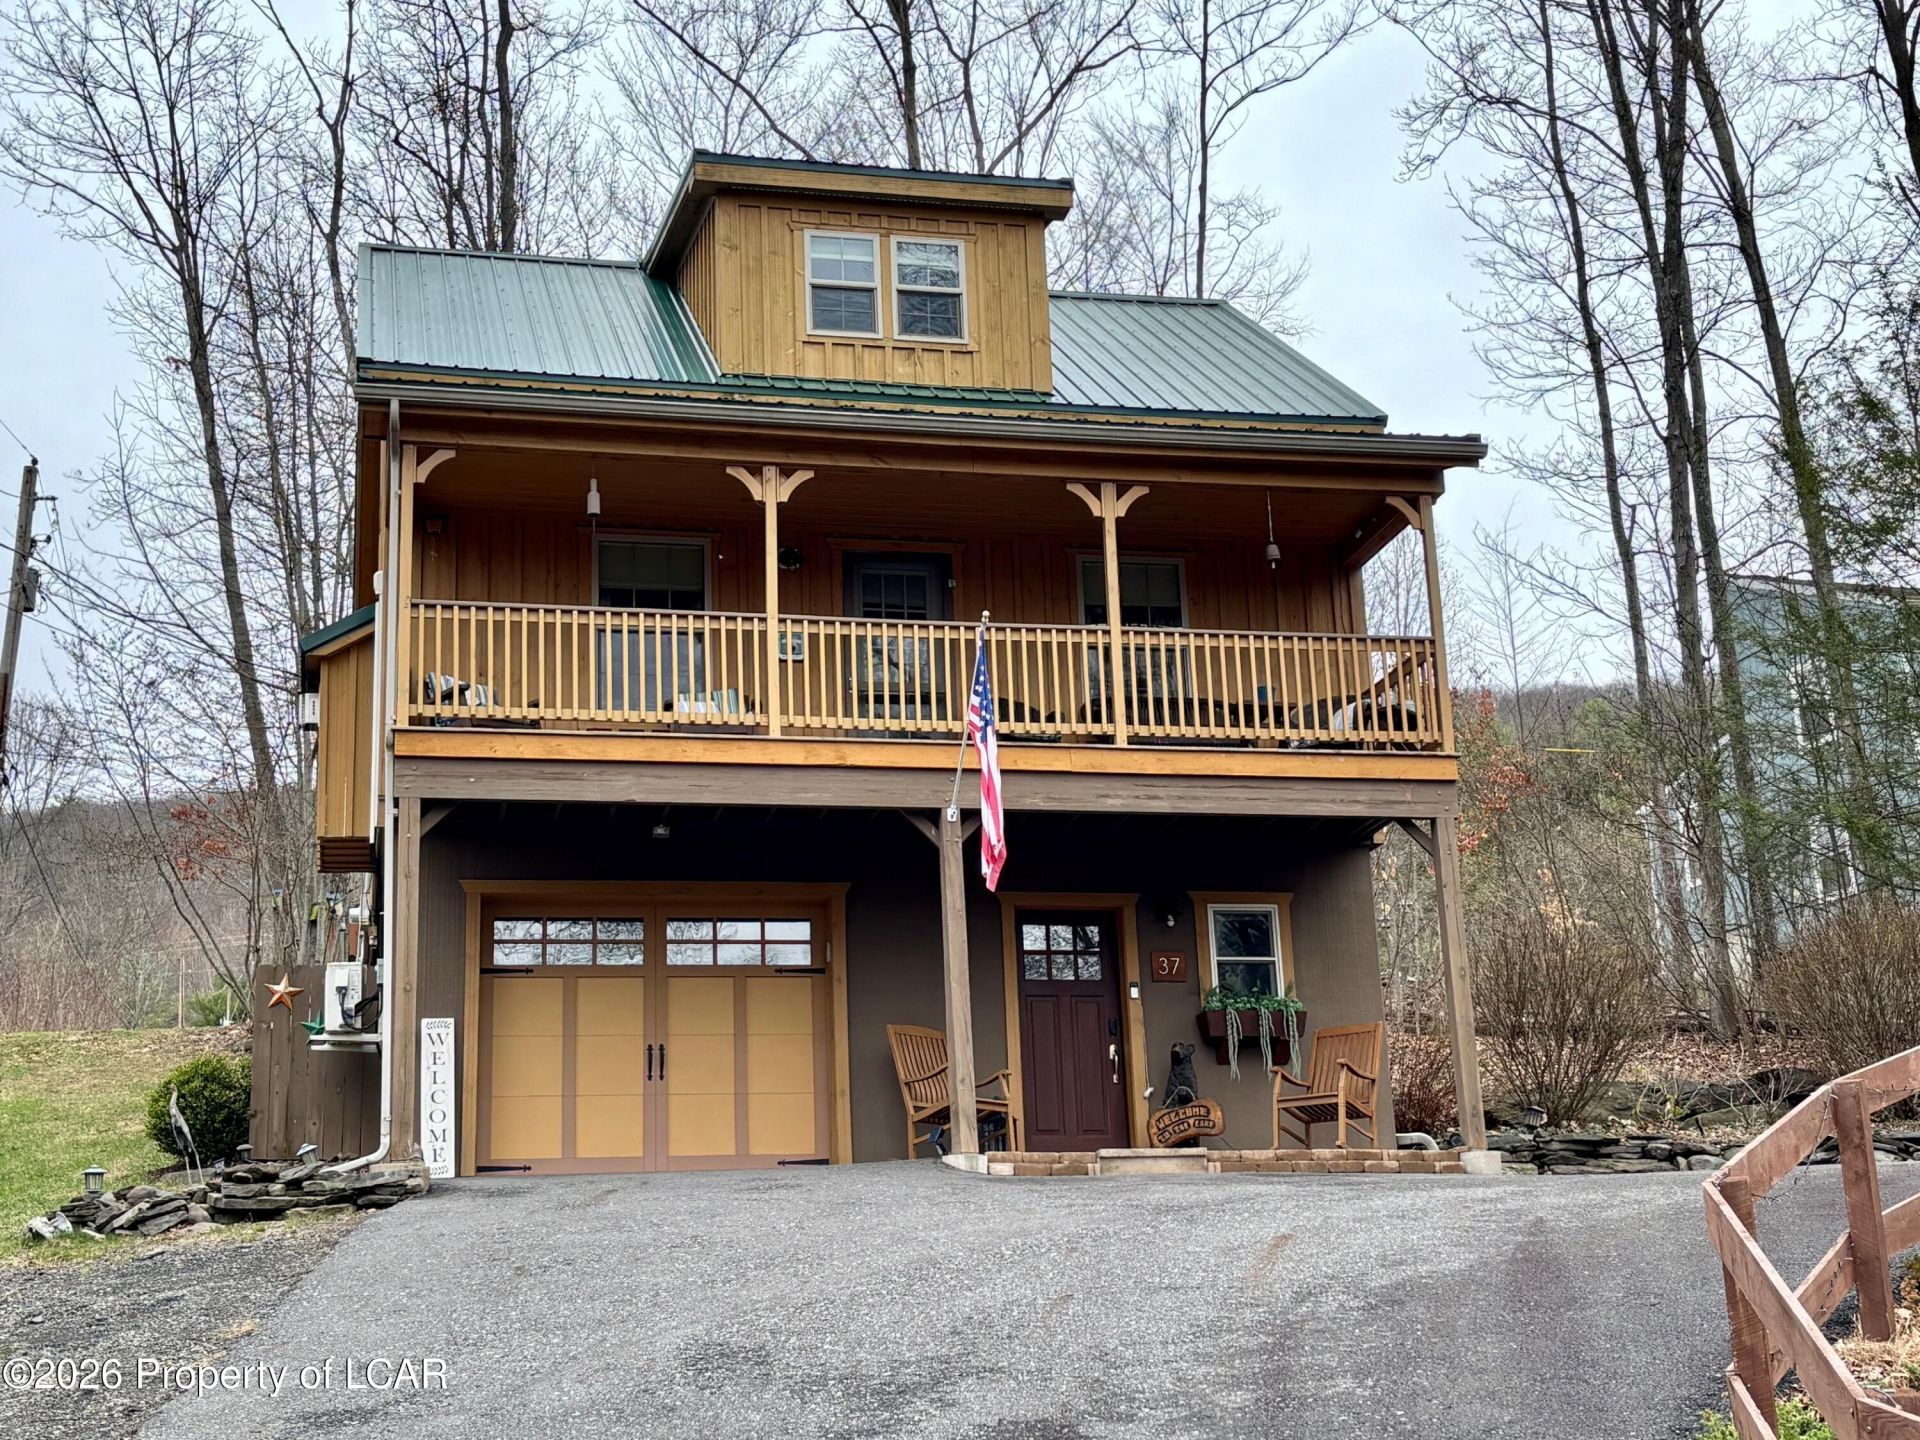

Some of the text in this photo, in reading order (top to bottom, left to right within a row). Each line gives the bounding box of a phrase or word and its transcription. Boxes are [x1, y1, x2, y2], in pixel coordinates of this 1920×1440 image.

[1158, 957, 1181, 975] 37
[426, 1032, 450, 1163] WELCOME
[1156, 1105, 1209, 1130] WELCOME
